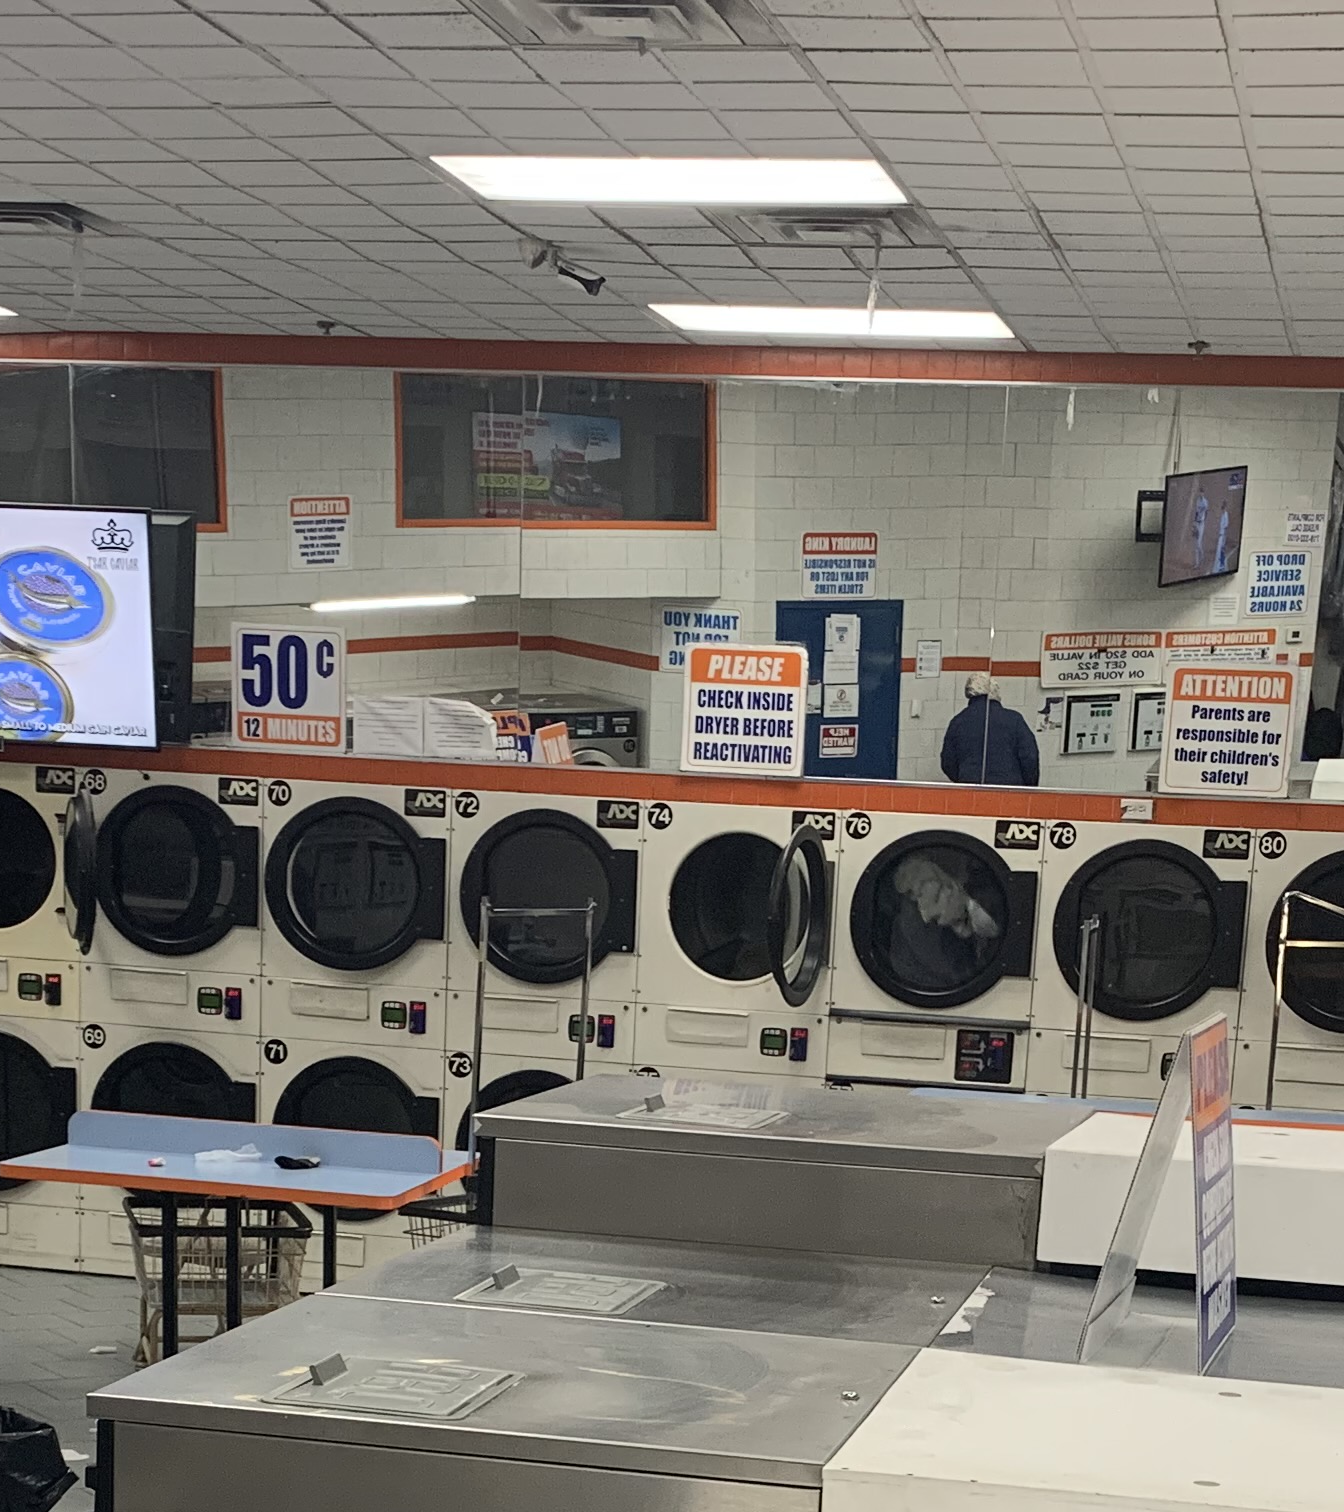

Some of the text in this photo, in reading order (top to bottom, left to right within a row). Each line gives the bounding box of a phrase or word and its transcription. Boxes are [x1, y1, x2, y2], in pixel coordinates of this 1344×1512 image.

[17, 562, 86, 596] CAVIAR
[707, 655, 785, 682] PLEASE
[1180, 675, 1286, 699] ATTENTION
[698, 689, 793, 711] CHECK INSIDE
[1191, 705, 1271, 723] Parents are
[243, 717, 260, 737] 12
[266, 717, 335, 743] MINUTES
[695, 716, 793, 738] DRYER BEFORE
[1176, 728, 1282, 746] responsible for
[693, 742, 792, 764] REACTIVATING
[1174, 748, 1279, 767] their children's
[85, 773, 105, 791] 68
[1200, 770, 1248, 786] safety!
[269, 784, 289, 802] 70
[457, 796, 478, 814] 72
[650, 807, 671, 825] 74
[847, 816, 869, 834] 76
[1052, 826, 1075, 845] 78
[1261, 836, 1284, 855] 80
[85, 1029, 104, 1045] 69
[266, 1044, 286, 1060] 71
[450, 1057, 471, 1074] 73
